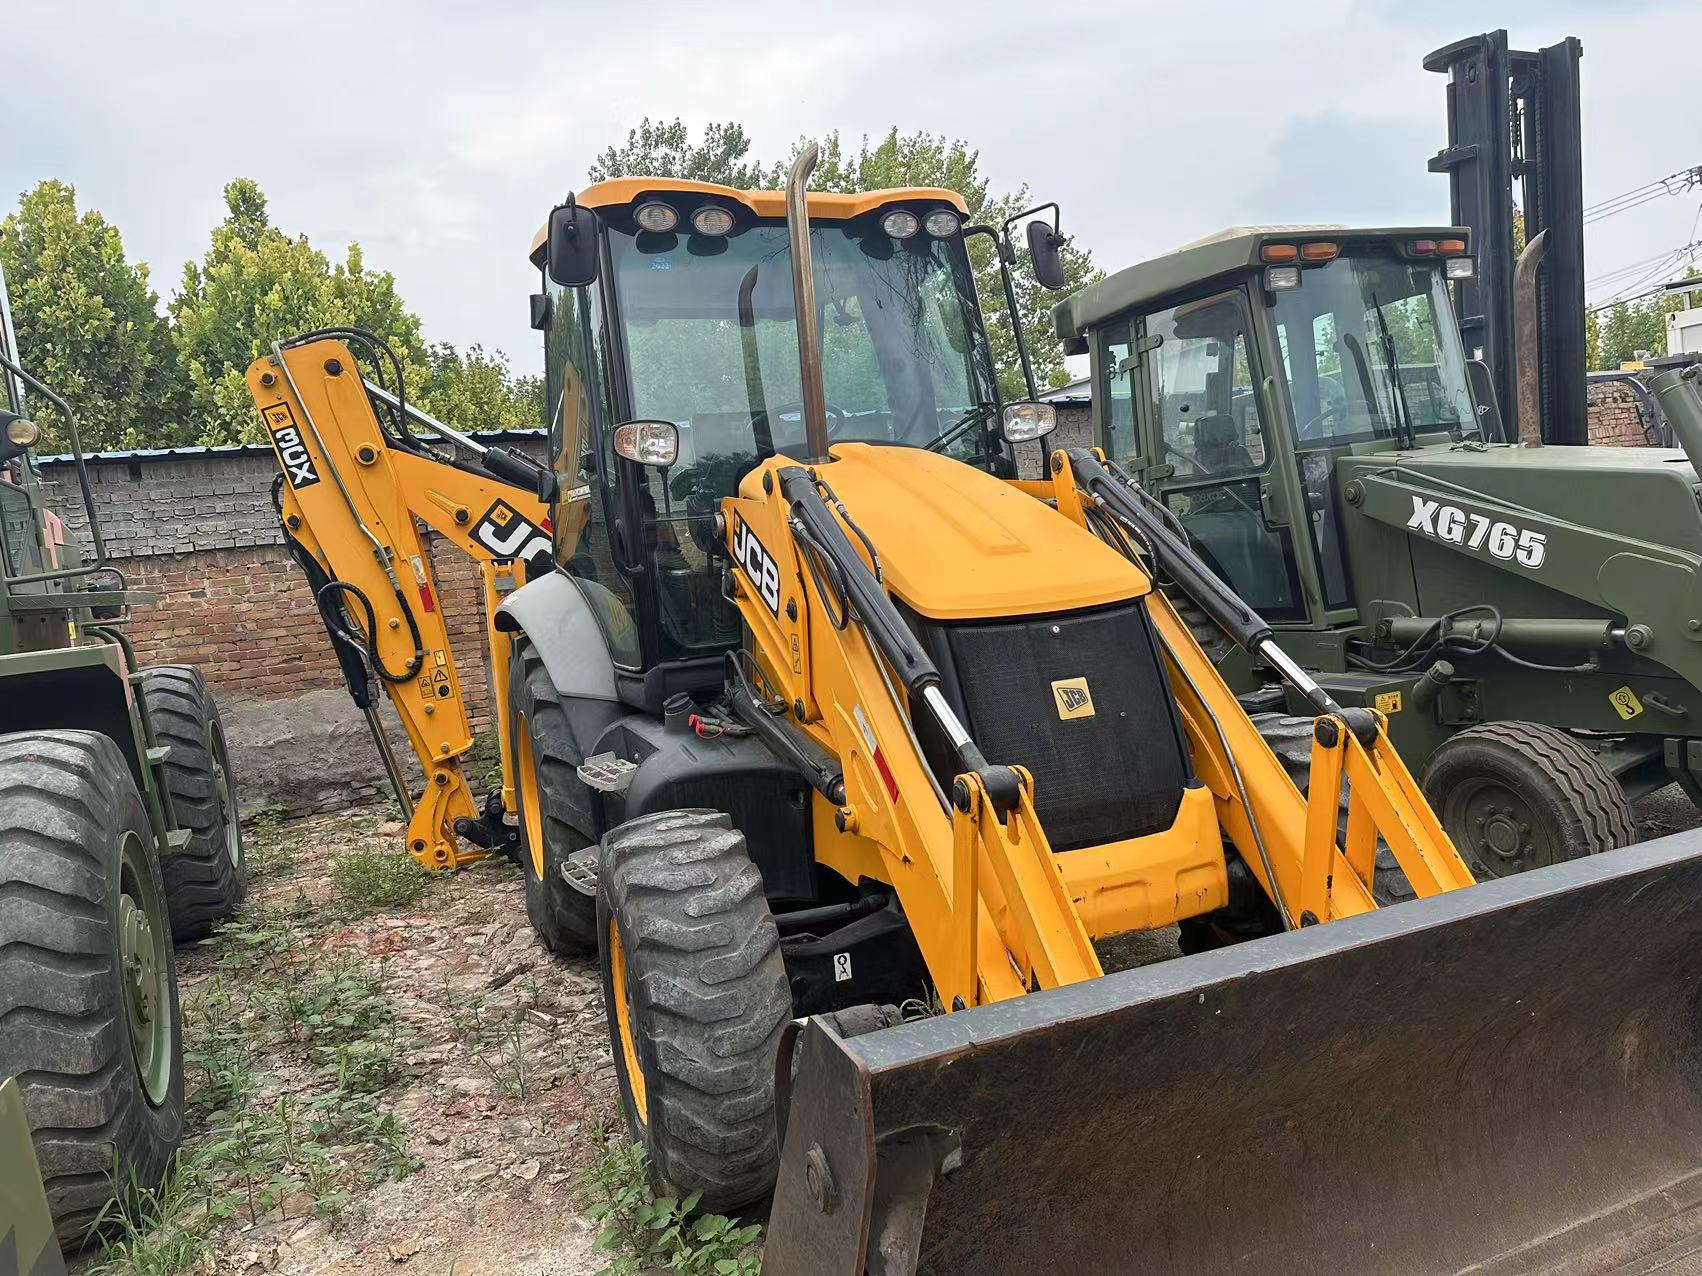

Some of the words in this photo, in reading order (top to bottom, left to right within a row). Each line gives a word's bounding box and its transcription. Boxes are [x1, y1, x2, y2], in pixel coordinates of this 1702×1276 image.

[275, 428, 317, 485] 3CX
[1406, 495, 1548, 569] XG765
[733, 522, 779, 612] JCB
[1060, 688, 1088, 710] JCB
